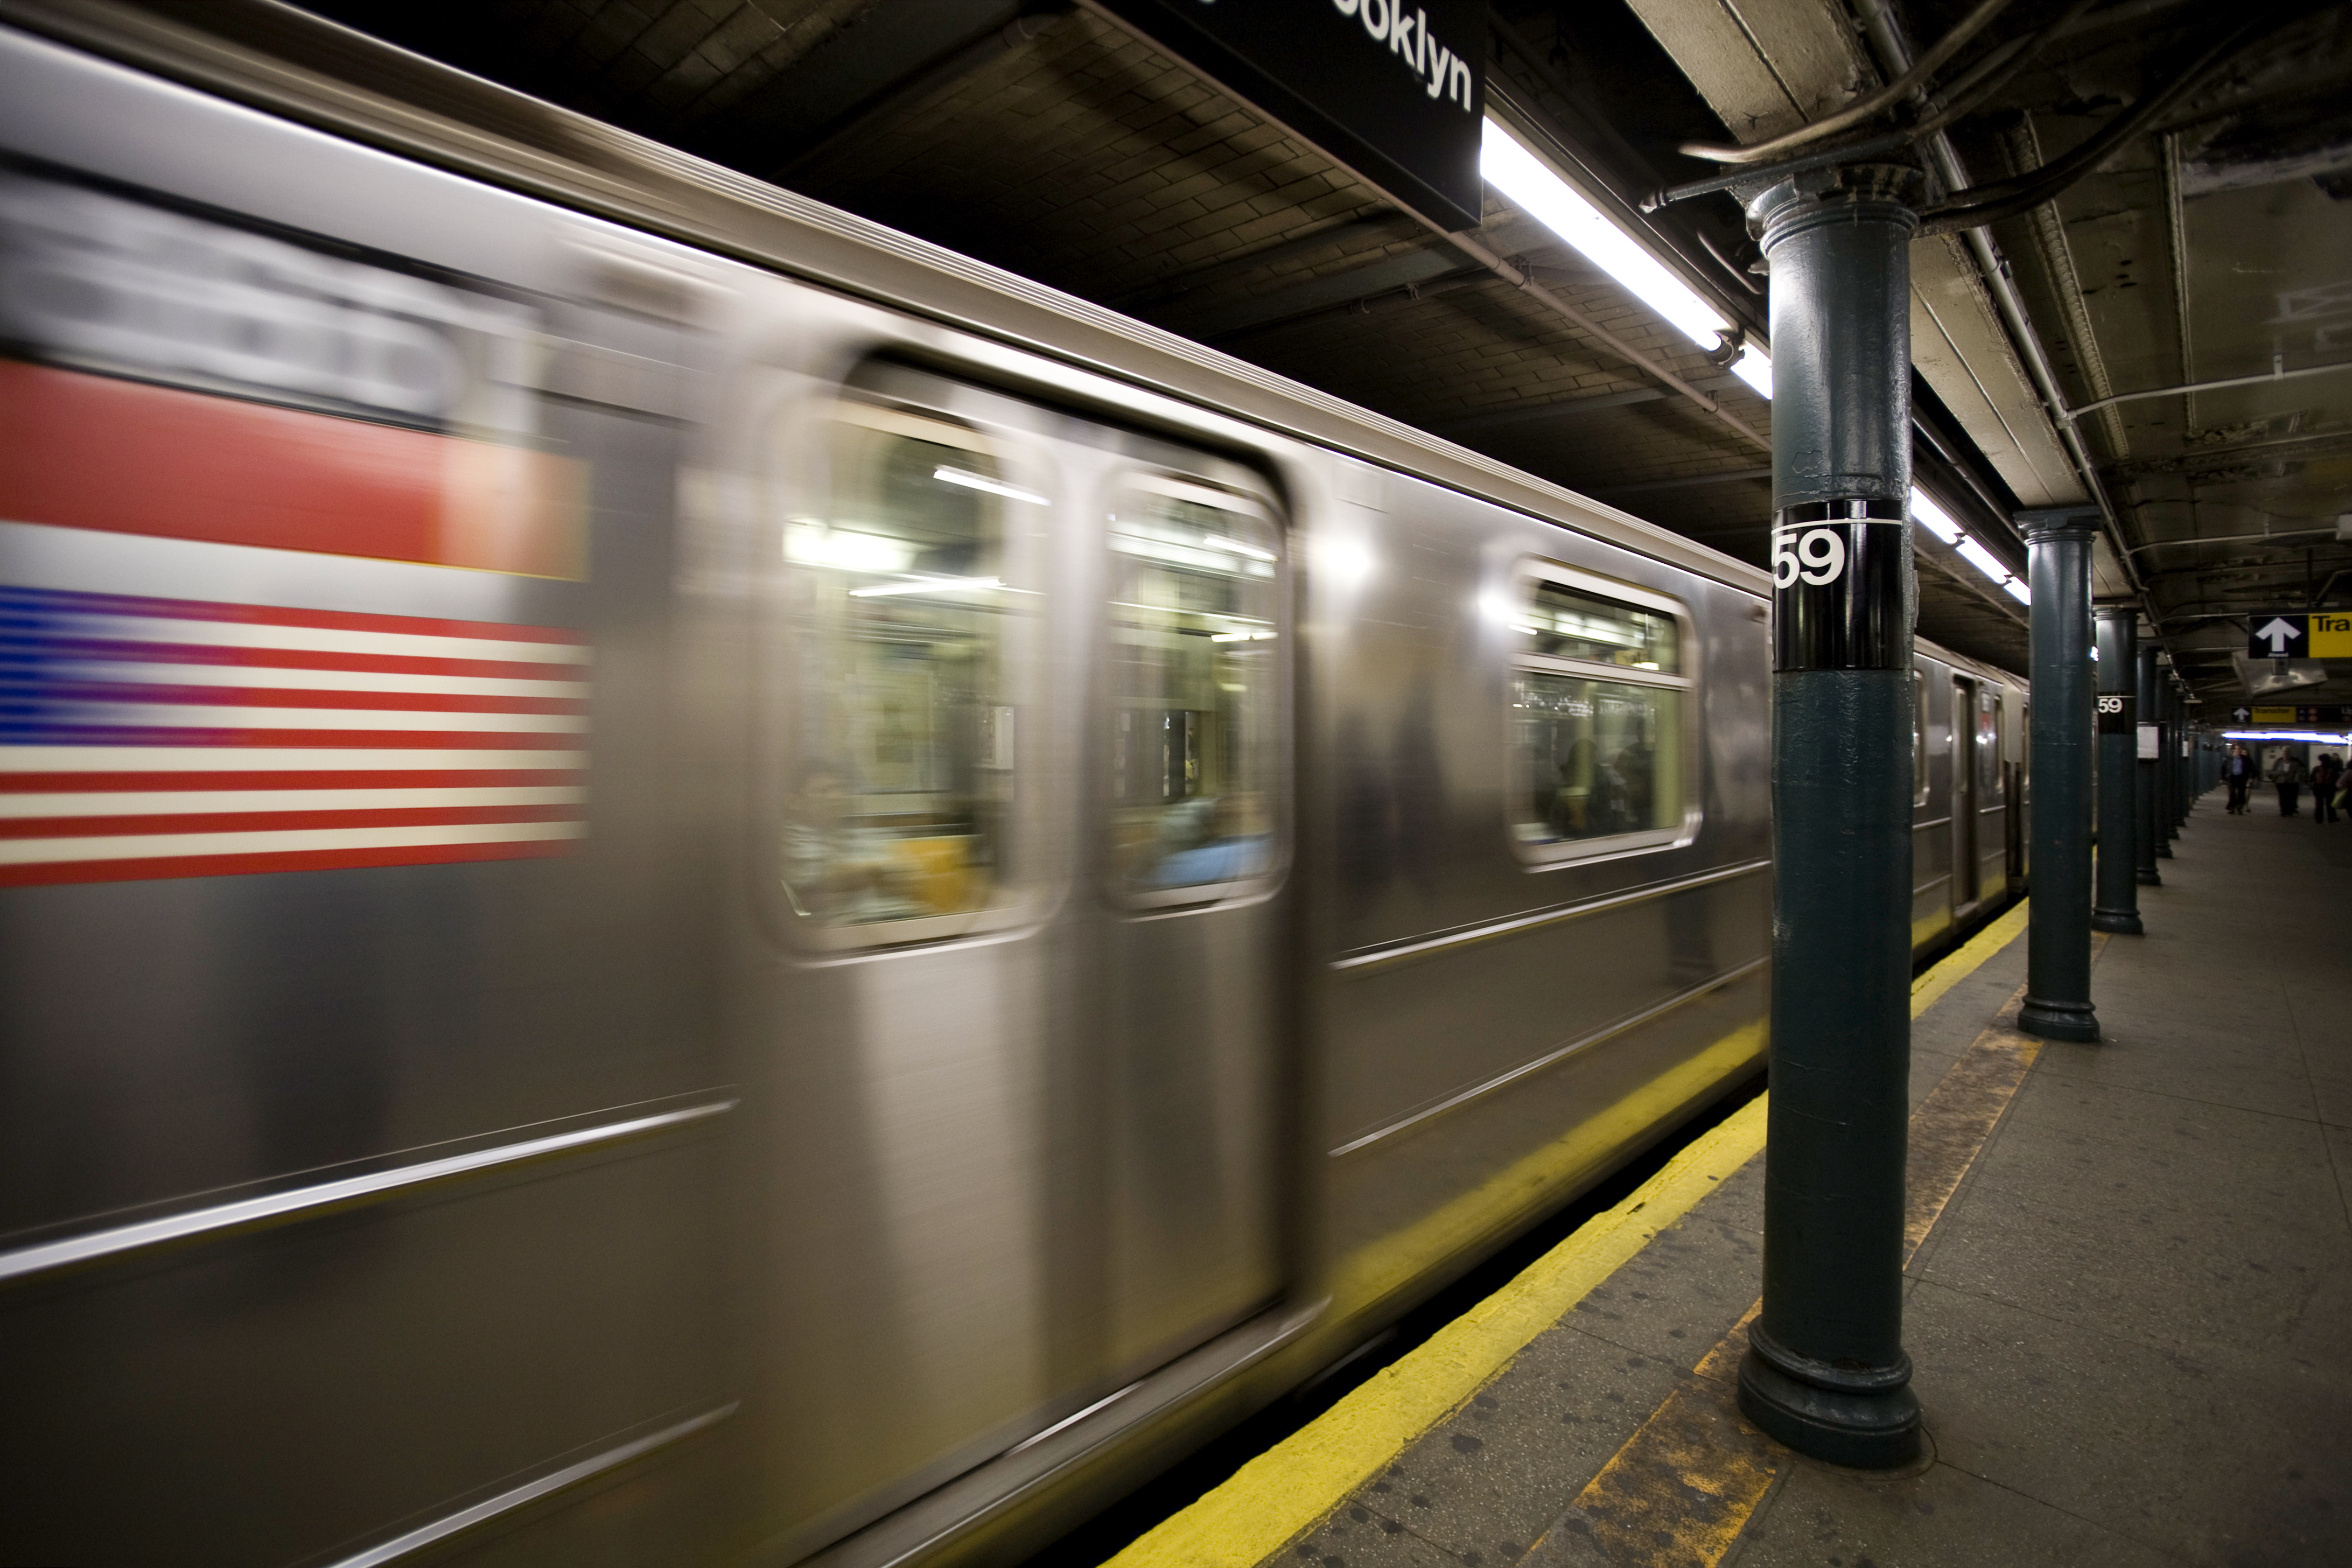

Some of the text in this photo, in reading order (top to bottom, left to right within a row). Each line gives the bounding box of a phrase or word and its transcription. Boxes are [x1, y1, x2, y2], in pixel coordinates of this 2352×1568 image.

[1772, 529, 1845, 589] 59
[2312, 615, 2351, 632] Tra
[2098, 698, 2123, 713] 59
